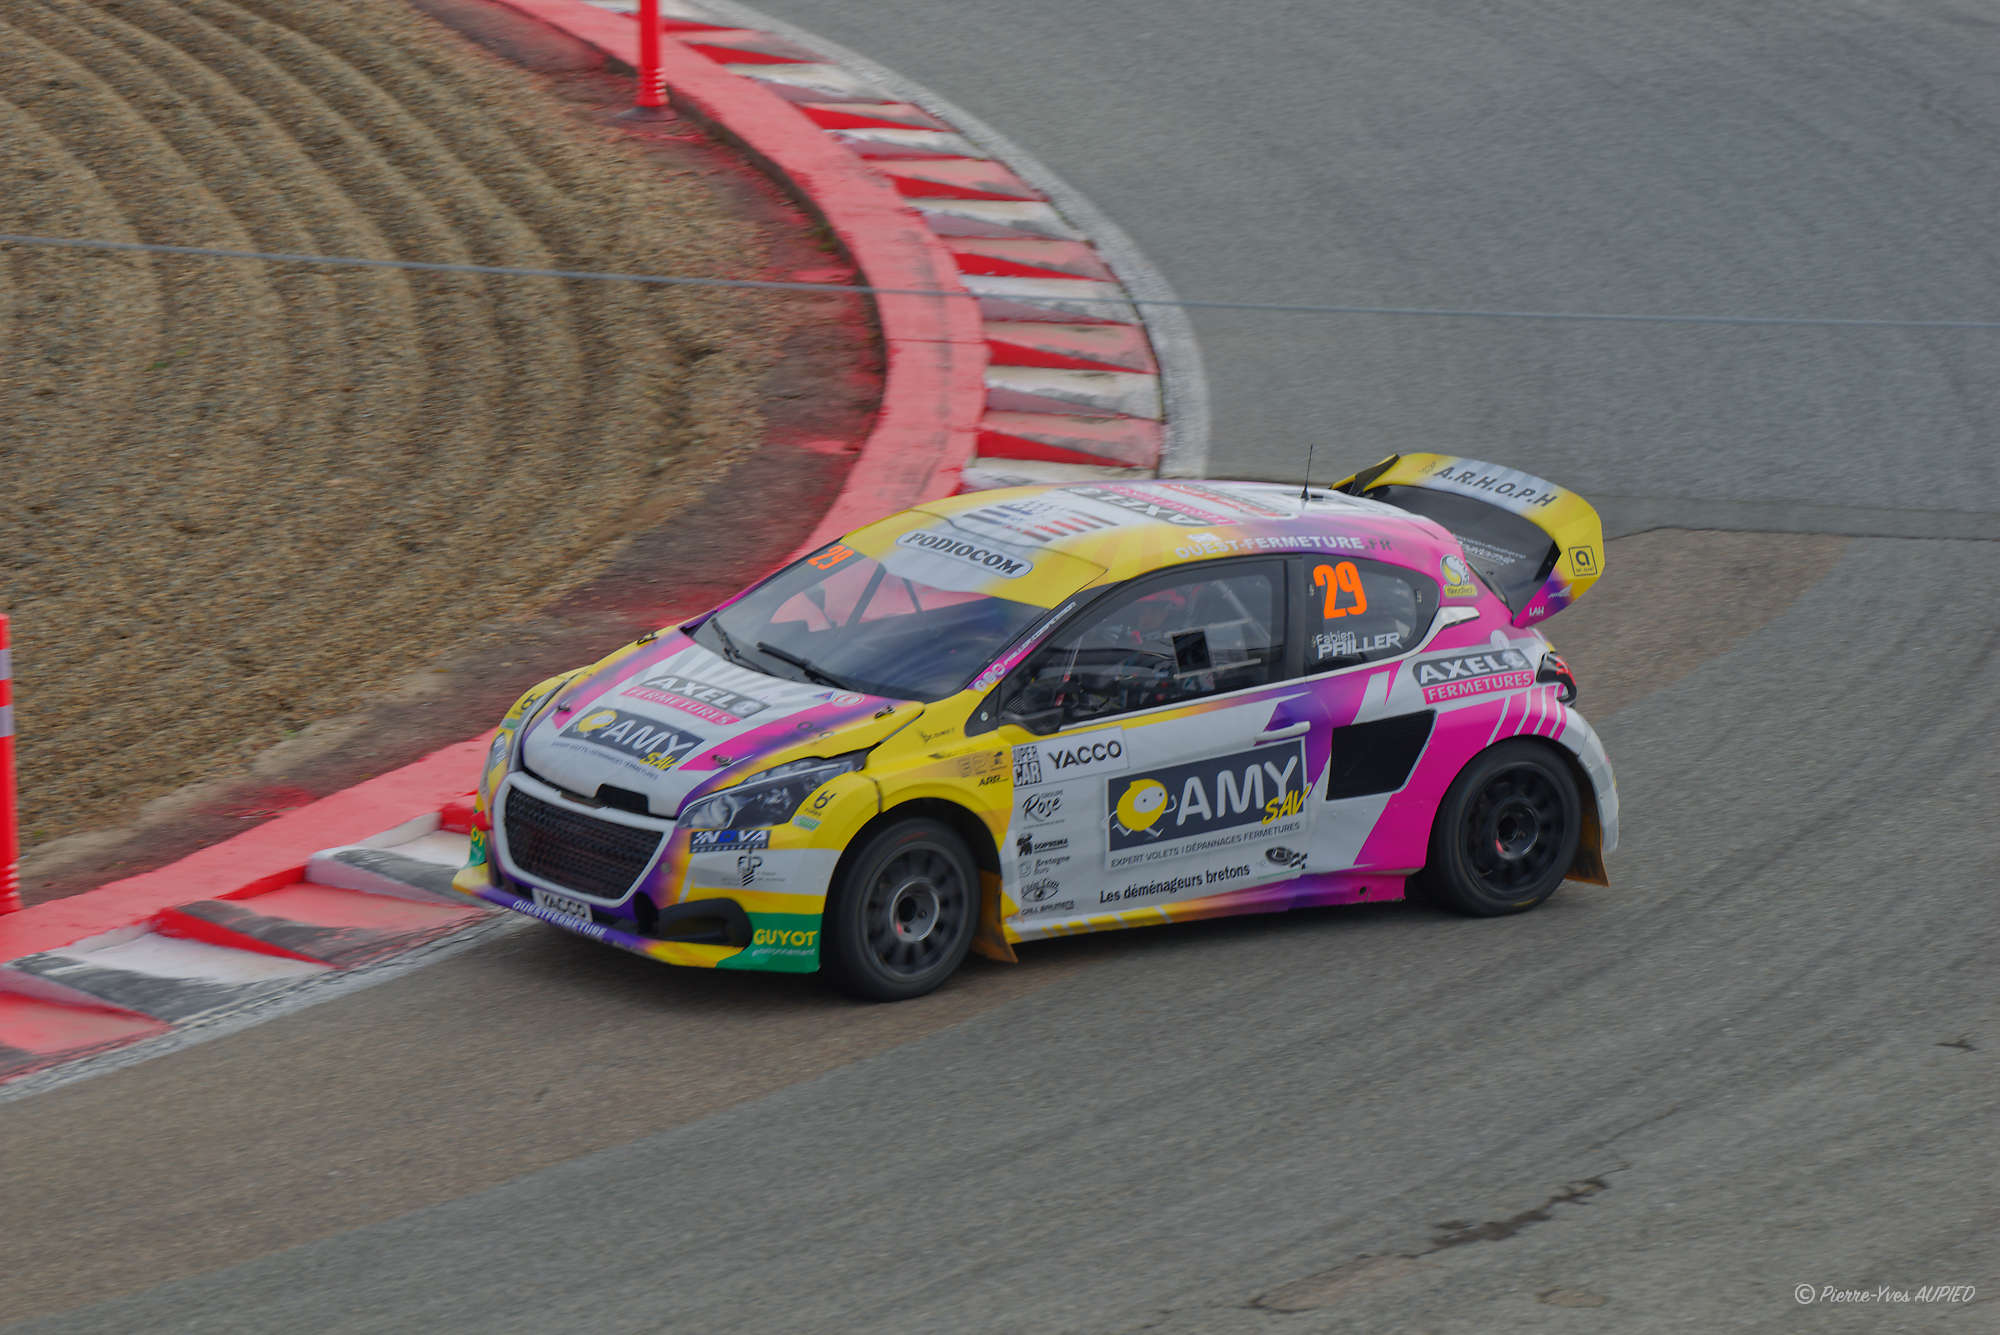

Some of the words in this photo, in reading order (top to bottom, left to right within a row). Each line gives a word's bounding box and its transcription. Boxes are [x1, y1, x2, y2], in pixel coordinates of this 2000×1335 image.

[807, 545, 854, 571] 29
[906, 531, 1023, 576] PODIOCOM
[1313, 561, 1367, 619] 29
[1420, 655, 1509, 684] AXEL
[648, 675, 734, 709] AXEL
[1428, 673, 1532, 701] FERMETURES
[600, 719, 694, 757] AMY
[1048, 740, 1122, 770] YACCO
[1014, 759, 1042, 786] CAR
[1176, 756, 1298, 826] AMY
[1262, 783, 1312, 825] SAV
[1100, 889, 1121, 905] Les
[1123, 876, 1203, 900] déménageurs
[1206, 863, 1251, 884] bretons
[753, 929, 818, 947] GUYOT
